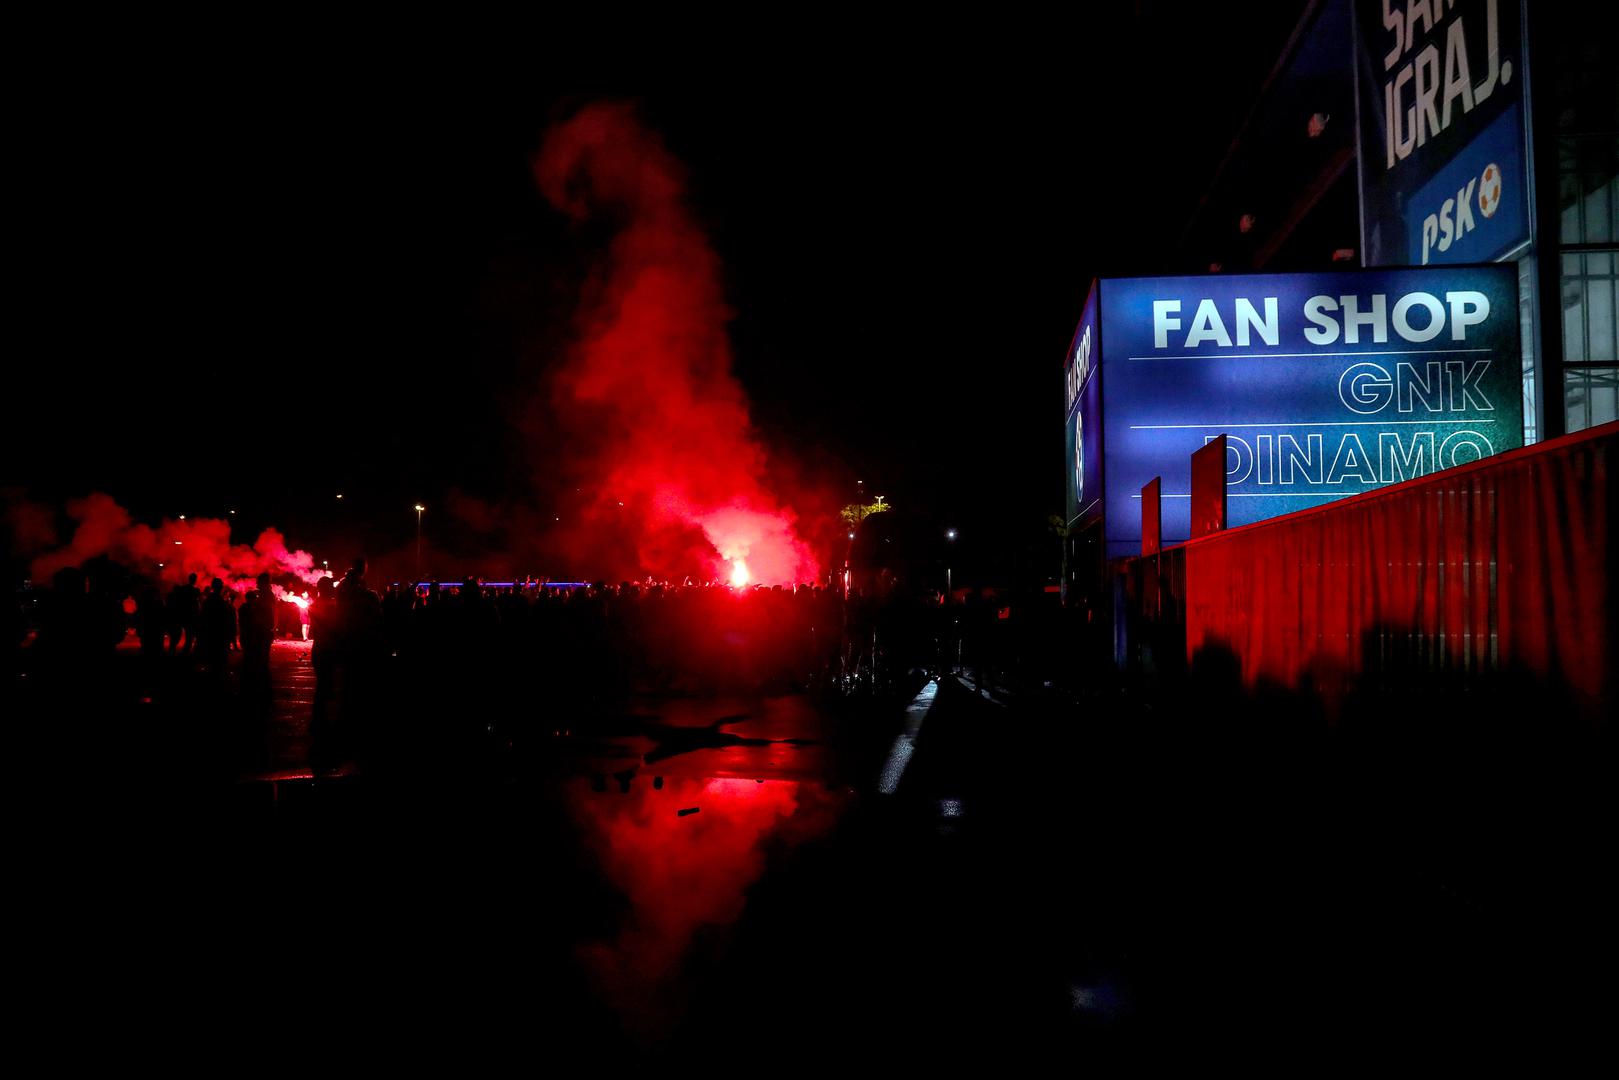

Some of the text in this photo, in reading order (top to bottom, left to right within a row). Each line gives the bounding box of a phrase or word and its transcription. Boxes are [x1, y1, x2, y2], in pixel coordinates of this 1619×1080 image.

[1382, 0, 1455, 72] SA
[1422, 176, 1477, 266] PSK
[1153, 290, 1490, 349] FAN SHOP
[1338, 360, 1494, 414] GNK
[1204, 430, 1494, 485] DINAMO
